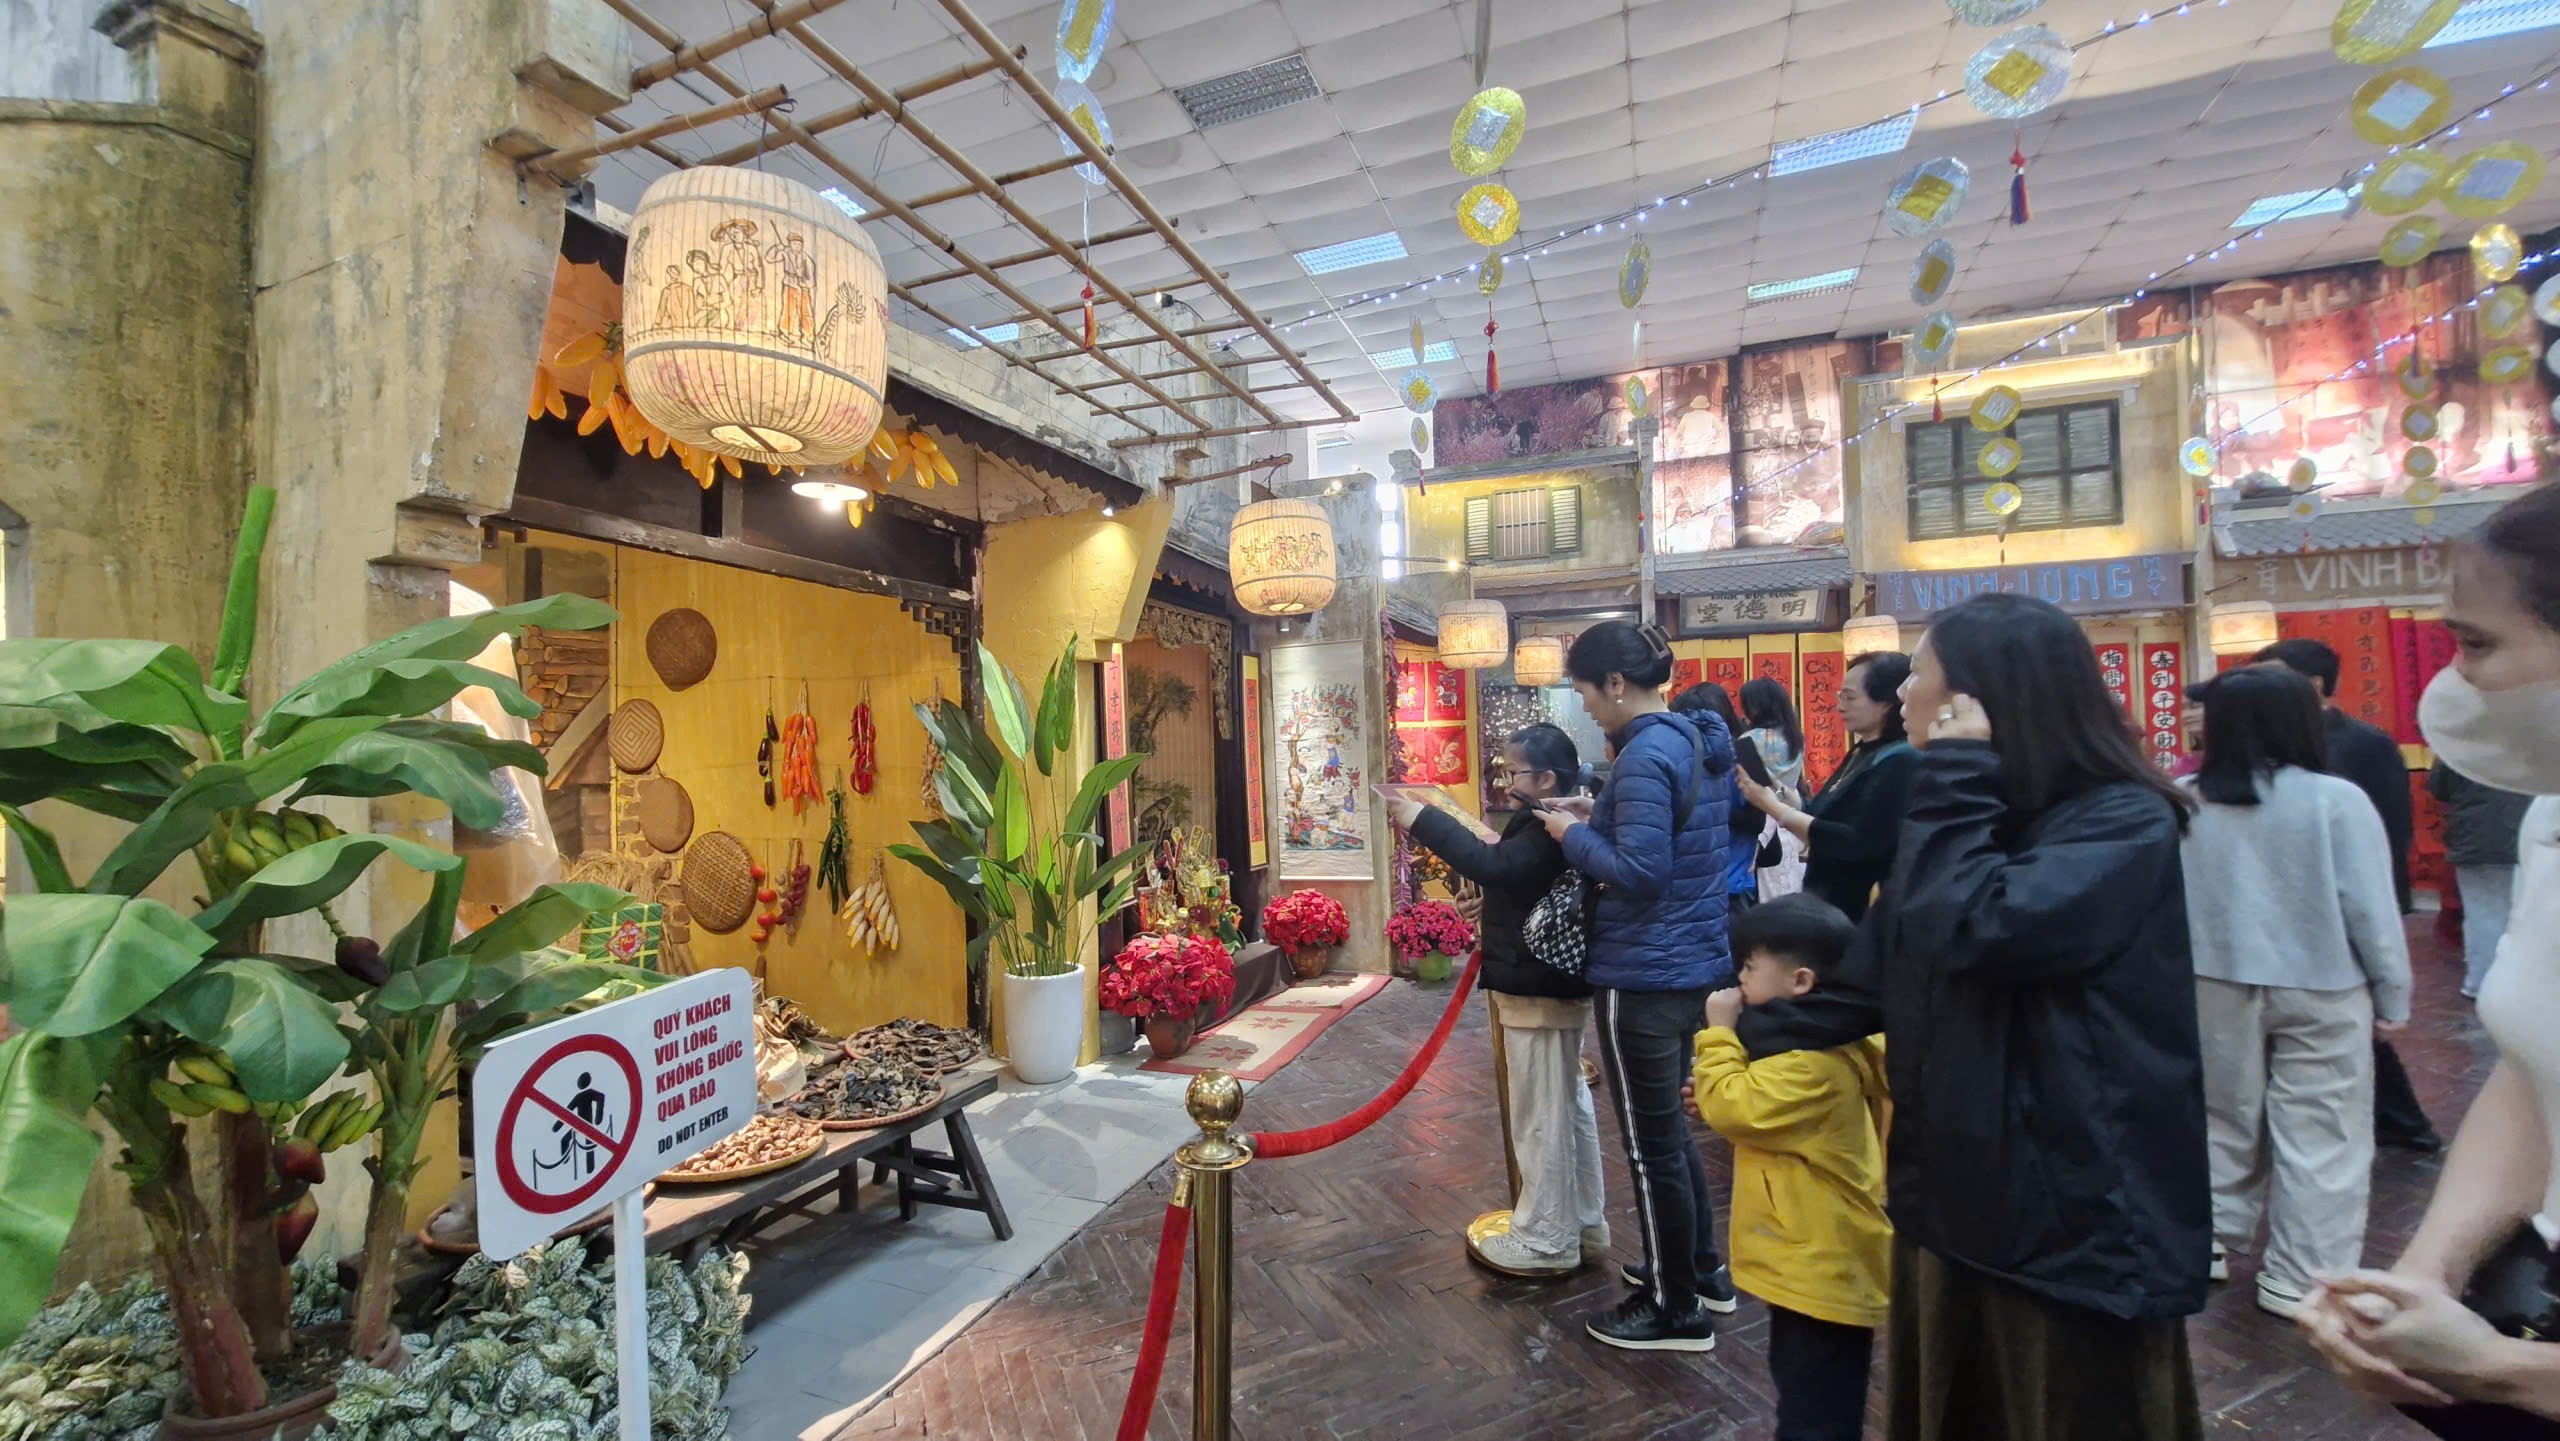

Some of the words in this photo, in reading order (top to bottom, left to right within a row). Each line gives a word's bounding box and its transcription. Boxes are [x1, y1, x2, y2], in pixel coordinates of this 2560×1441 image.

[2295, 553, 2402, 592] VINH
[653, 1008, 681, 1040] QUÝ
[685, 993, 731, 1026] KHÁCH
[655, 1040, 679, 1066] VUI
[683, 1025, 718, 1055] LÒNG
[656, 1057, 704, 1094] KHÔNG
[708, 1039, 743, 1070] BƯỚC
[657, 1093, 685, 1122] QUA
[689, 1078, 716, 1106] RÀO
[658, 1135, 673, 1154] DO
[676, 1122, 696, 1145] NOT
[699, 1106, 729, 1133] ENTER
